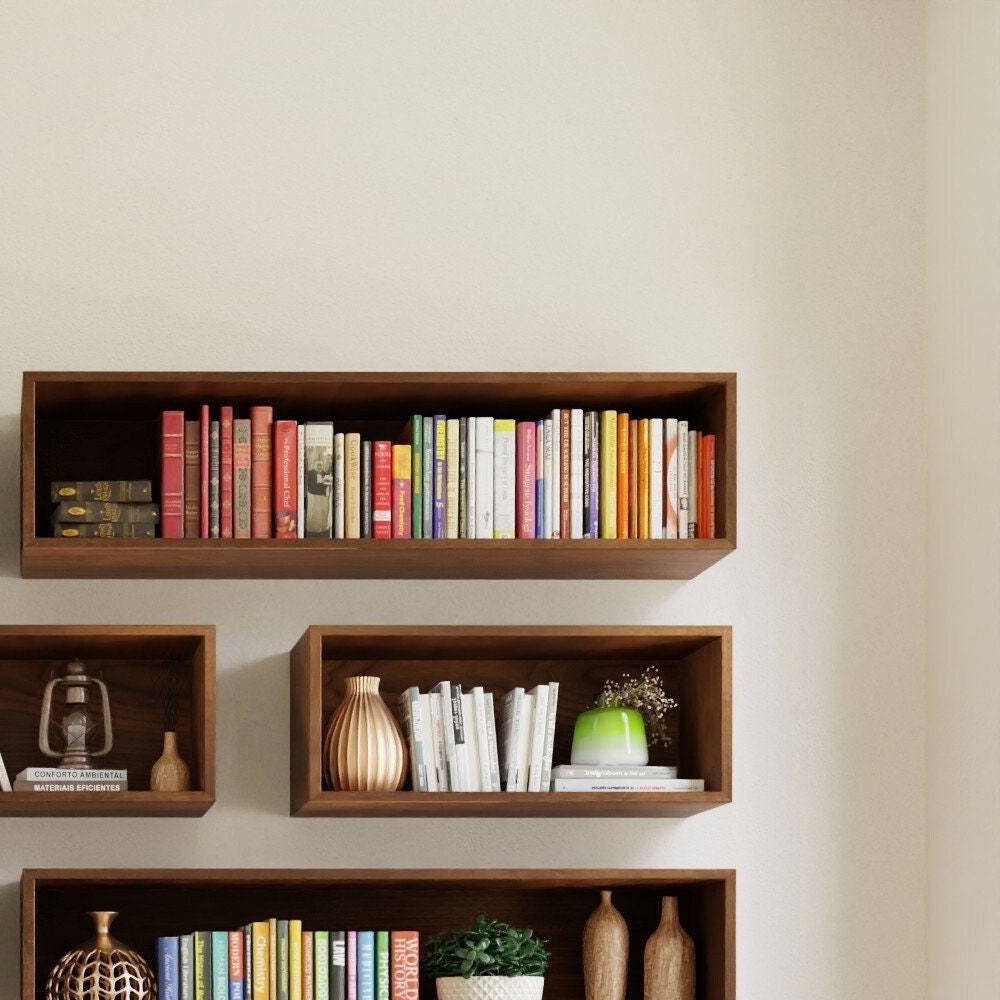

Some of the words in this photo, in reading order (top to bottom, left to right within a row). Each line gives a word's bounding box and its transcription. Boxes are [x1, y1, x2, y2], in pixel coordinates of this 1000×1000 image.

[350, 439, 358, 480] CookWise
[522, 464, 533, 498] Smagens
[398, 507, 406, 536] Chemistry
[34, 770, 78, 778] CONFORTO
[79, 771, 124, 779] AMBIENTAL
[34, 784, 75, 792] MATERIAIS
[76, 784, 121, 792] EFICIENTES
[180, 937, 189, 964] English
[196, 954, 205, 979] History
[217, 939, 225, 975] HUMAN
[231, 932, 240, 977] MODERN
[255, 935, 267, 993] Chemistry
[332, 940, 346, 967] LAW
[198, 979, 205, 989] of
[361, 943, 372, 1000] MEDICINE
[394, 937, 406, 1000] HISTORY
[405, 937, 419, 1000] WORLD
